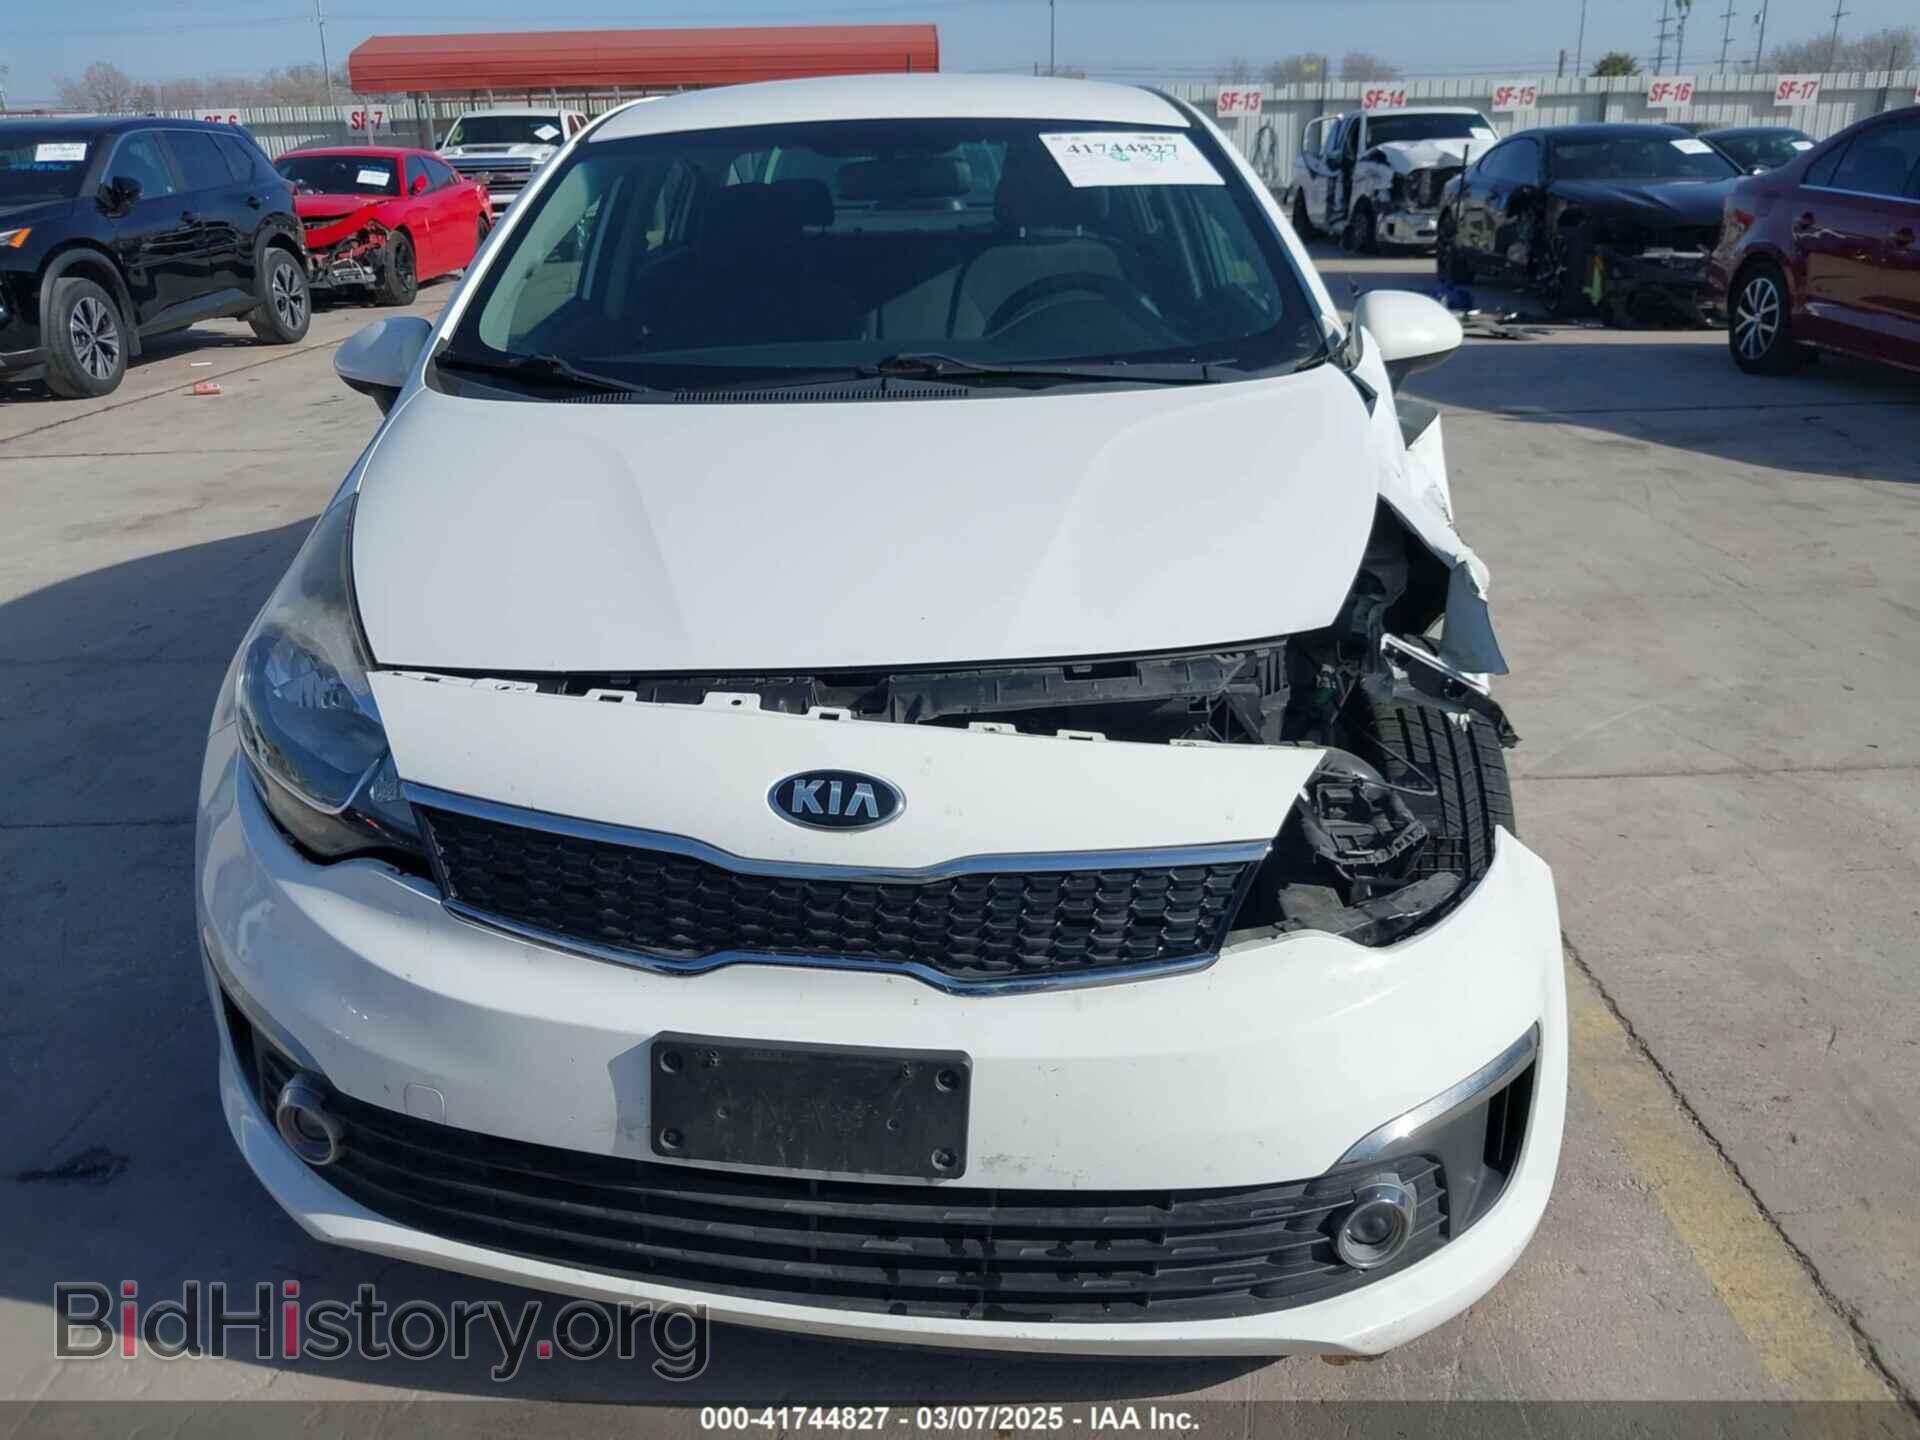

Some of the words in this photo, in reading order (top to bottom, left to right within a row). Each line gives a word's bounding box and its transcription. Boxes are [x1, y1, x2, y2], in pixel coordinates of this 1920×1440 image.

[1363, 90, 1405, 109] SF-14
[1492, 86, 1537, 106] SF-15
[1649, 82, 1692, 101] SF-16
[1776, 80, 1819, 100] SF-17
[1217, 92, 1261, 112] SF-13
[791, 779, 880, 818] KIA
